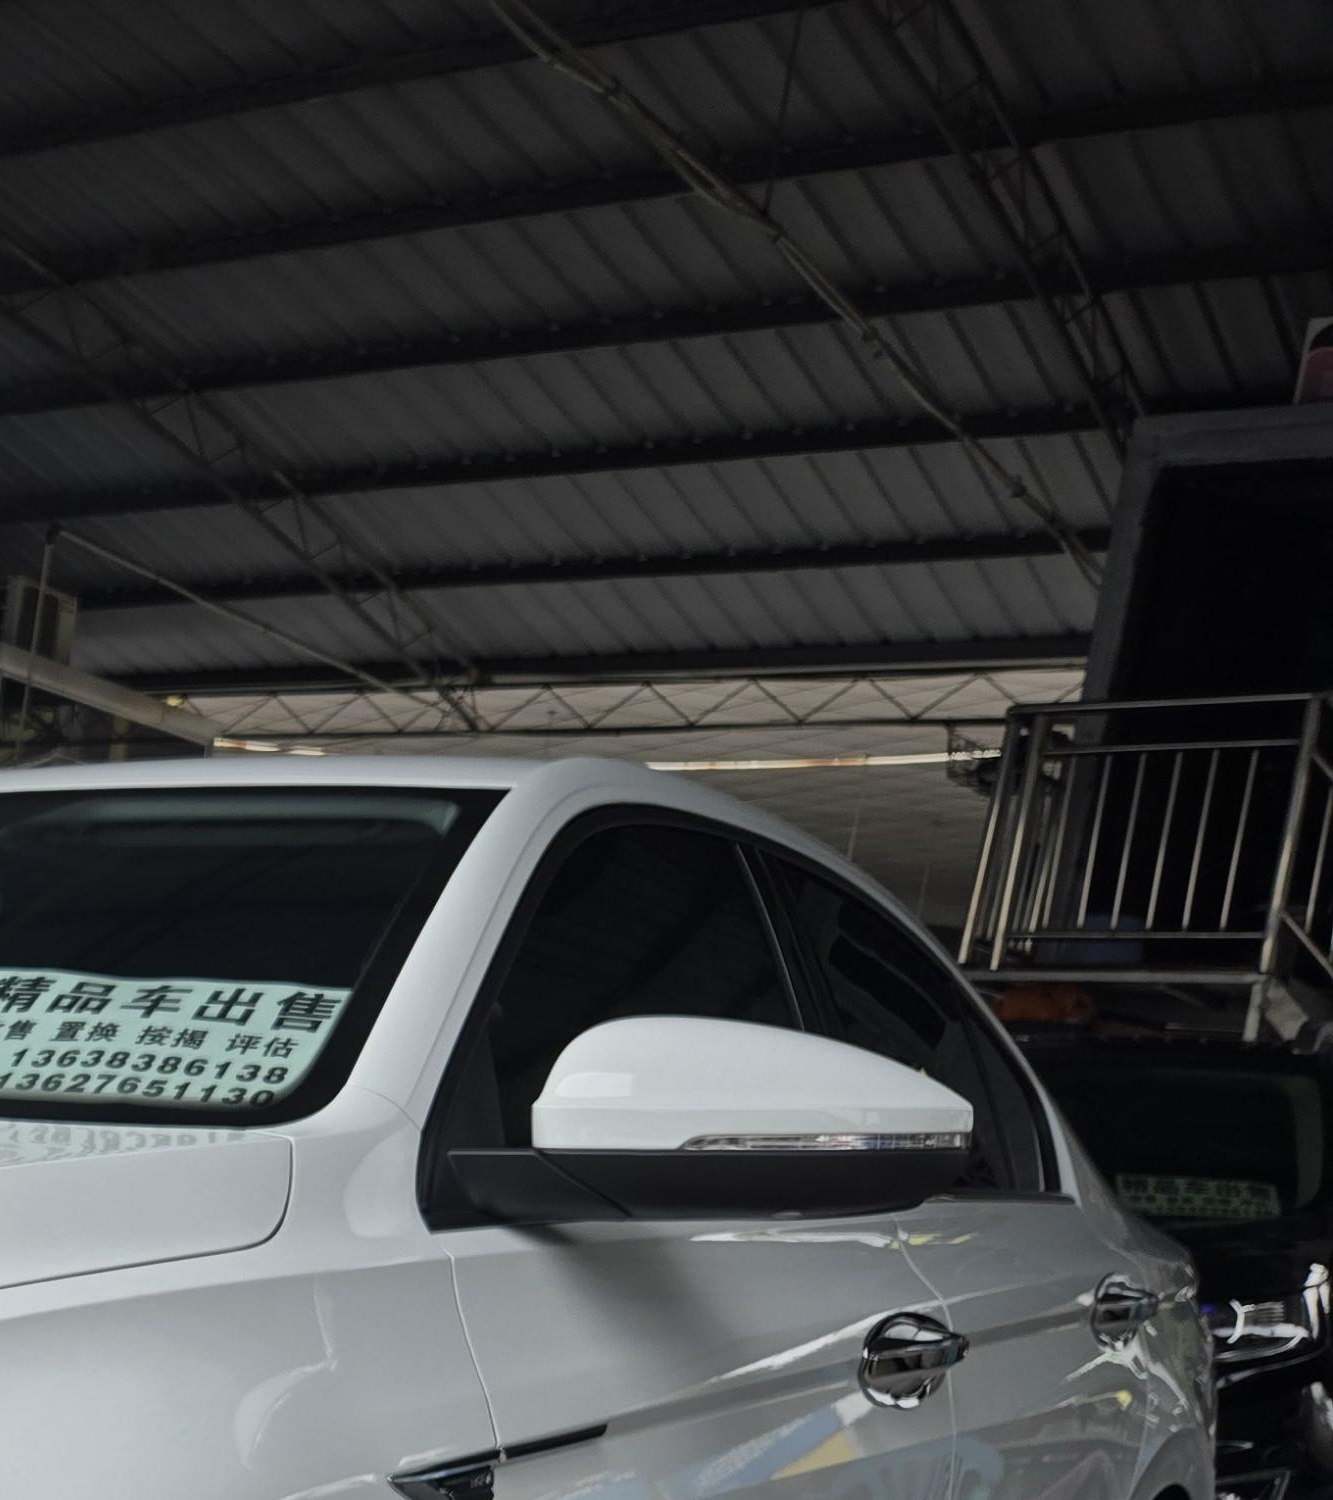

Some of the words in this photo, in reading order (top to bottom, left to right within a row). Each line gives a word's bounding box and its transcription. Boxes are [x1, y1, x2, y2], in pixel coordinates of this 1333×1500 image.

[49, 1020, 122, 1043] 置换
[135, 1024, 210, 1050] 按揭
[224, 1032, 300, 1059] 评估
[10, 1048, 290, 1085] 13638386138
